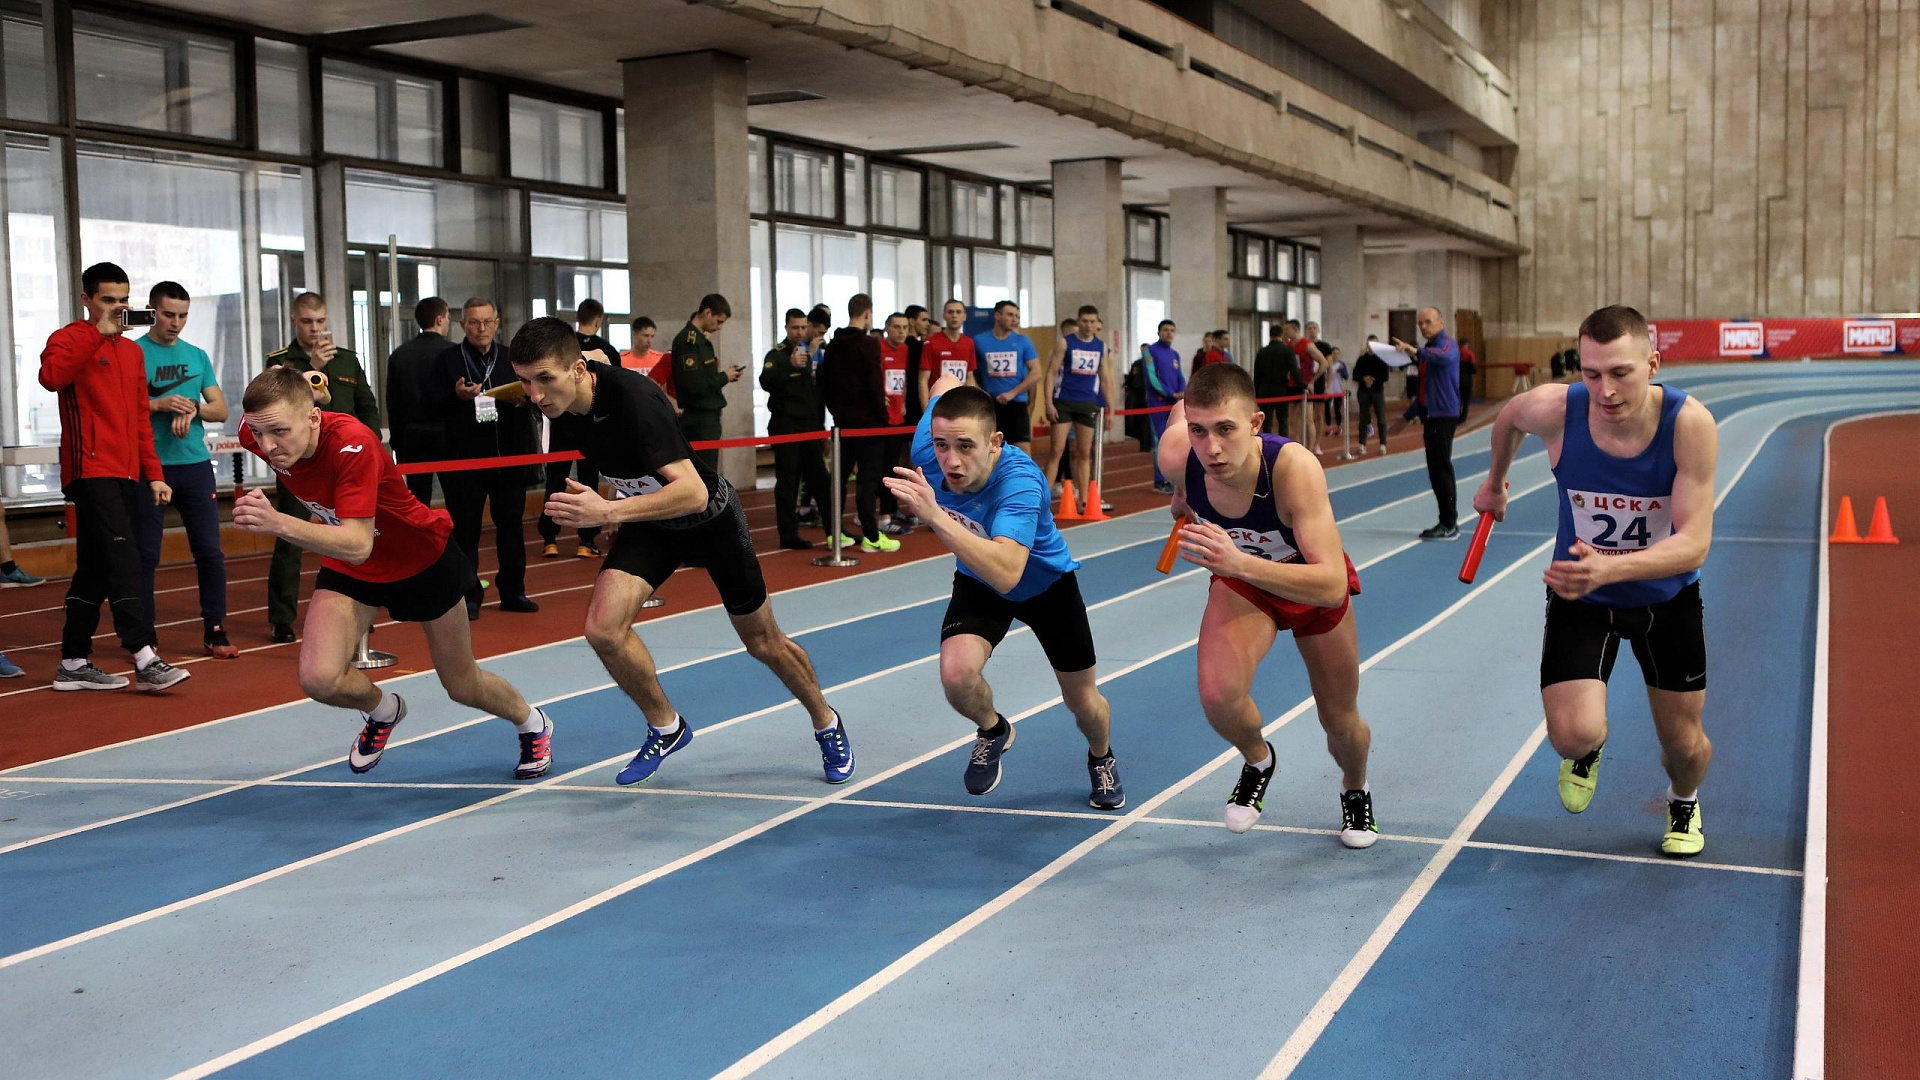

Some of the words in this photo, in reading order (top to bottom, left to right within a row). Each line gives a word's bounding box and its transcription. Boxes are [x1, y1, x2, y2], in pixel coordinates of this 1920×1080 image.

[993, 360, 1011, 372] 22
[1079, 358, 1095, 370] 24
[154, 364, 189, 382] NIKE
[893, 377, 904, 390] 20
[215, 441, 241, 451] polan
[1594, 496, 1662, 511] ЦСКА
[1591, 513, 1651, 547] 24
[1228, 530, 1273, 544] СКА
